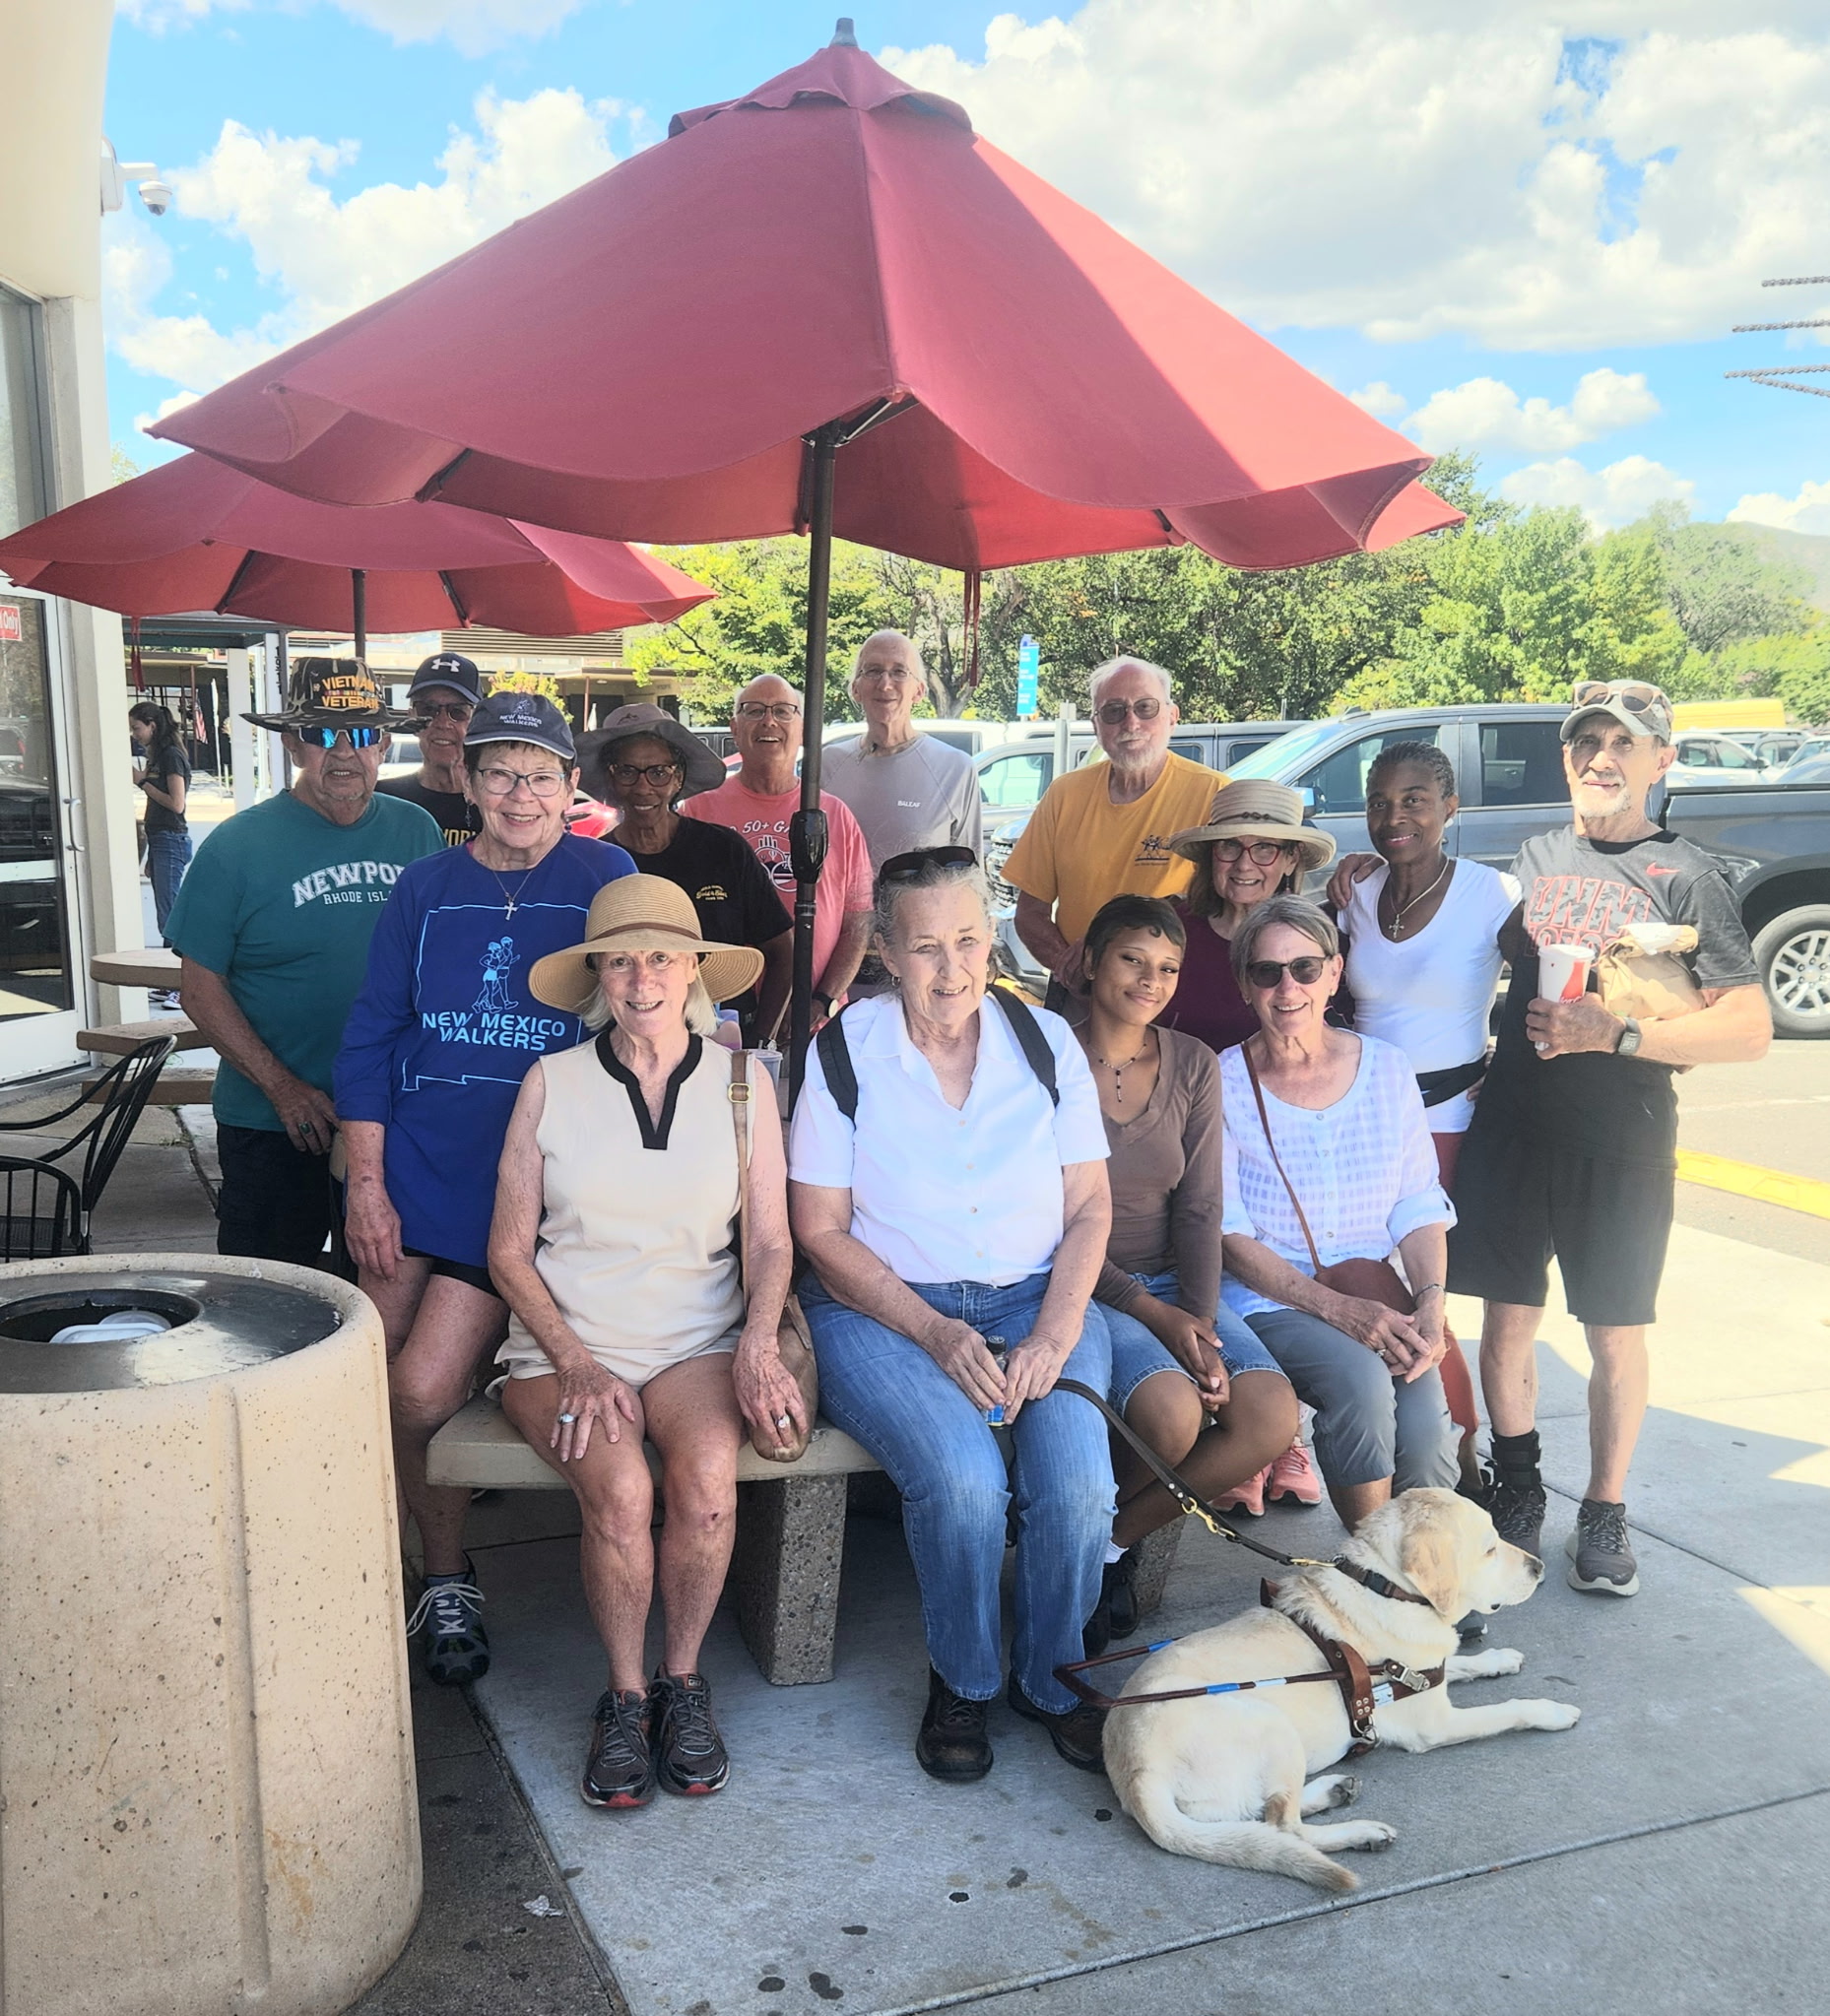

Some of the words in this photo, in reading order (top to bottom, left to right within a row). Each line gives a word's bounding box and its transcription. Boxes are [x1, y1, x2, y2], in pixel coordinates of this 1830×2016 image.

[322, 676, 374, 691] VIETNAM
[322, 696, 379, 709] VETERAN
[742, 819, 770, 833] 50+
[292, 860, 406, 908] NEWPO
[323, 890, 363, 905] RHODE
[367, 890, 393, 903] ISL
[1528, 876, 1652, 938] UNM
[422, 1010, 473, 1028] NEW
[481, 1012, 565, 1037] MEXICO
[439, 1026, 546, 1051] WALKERS
